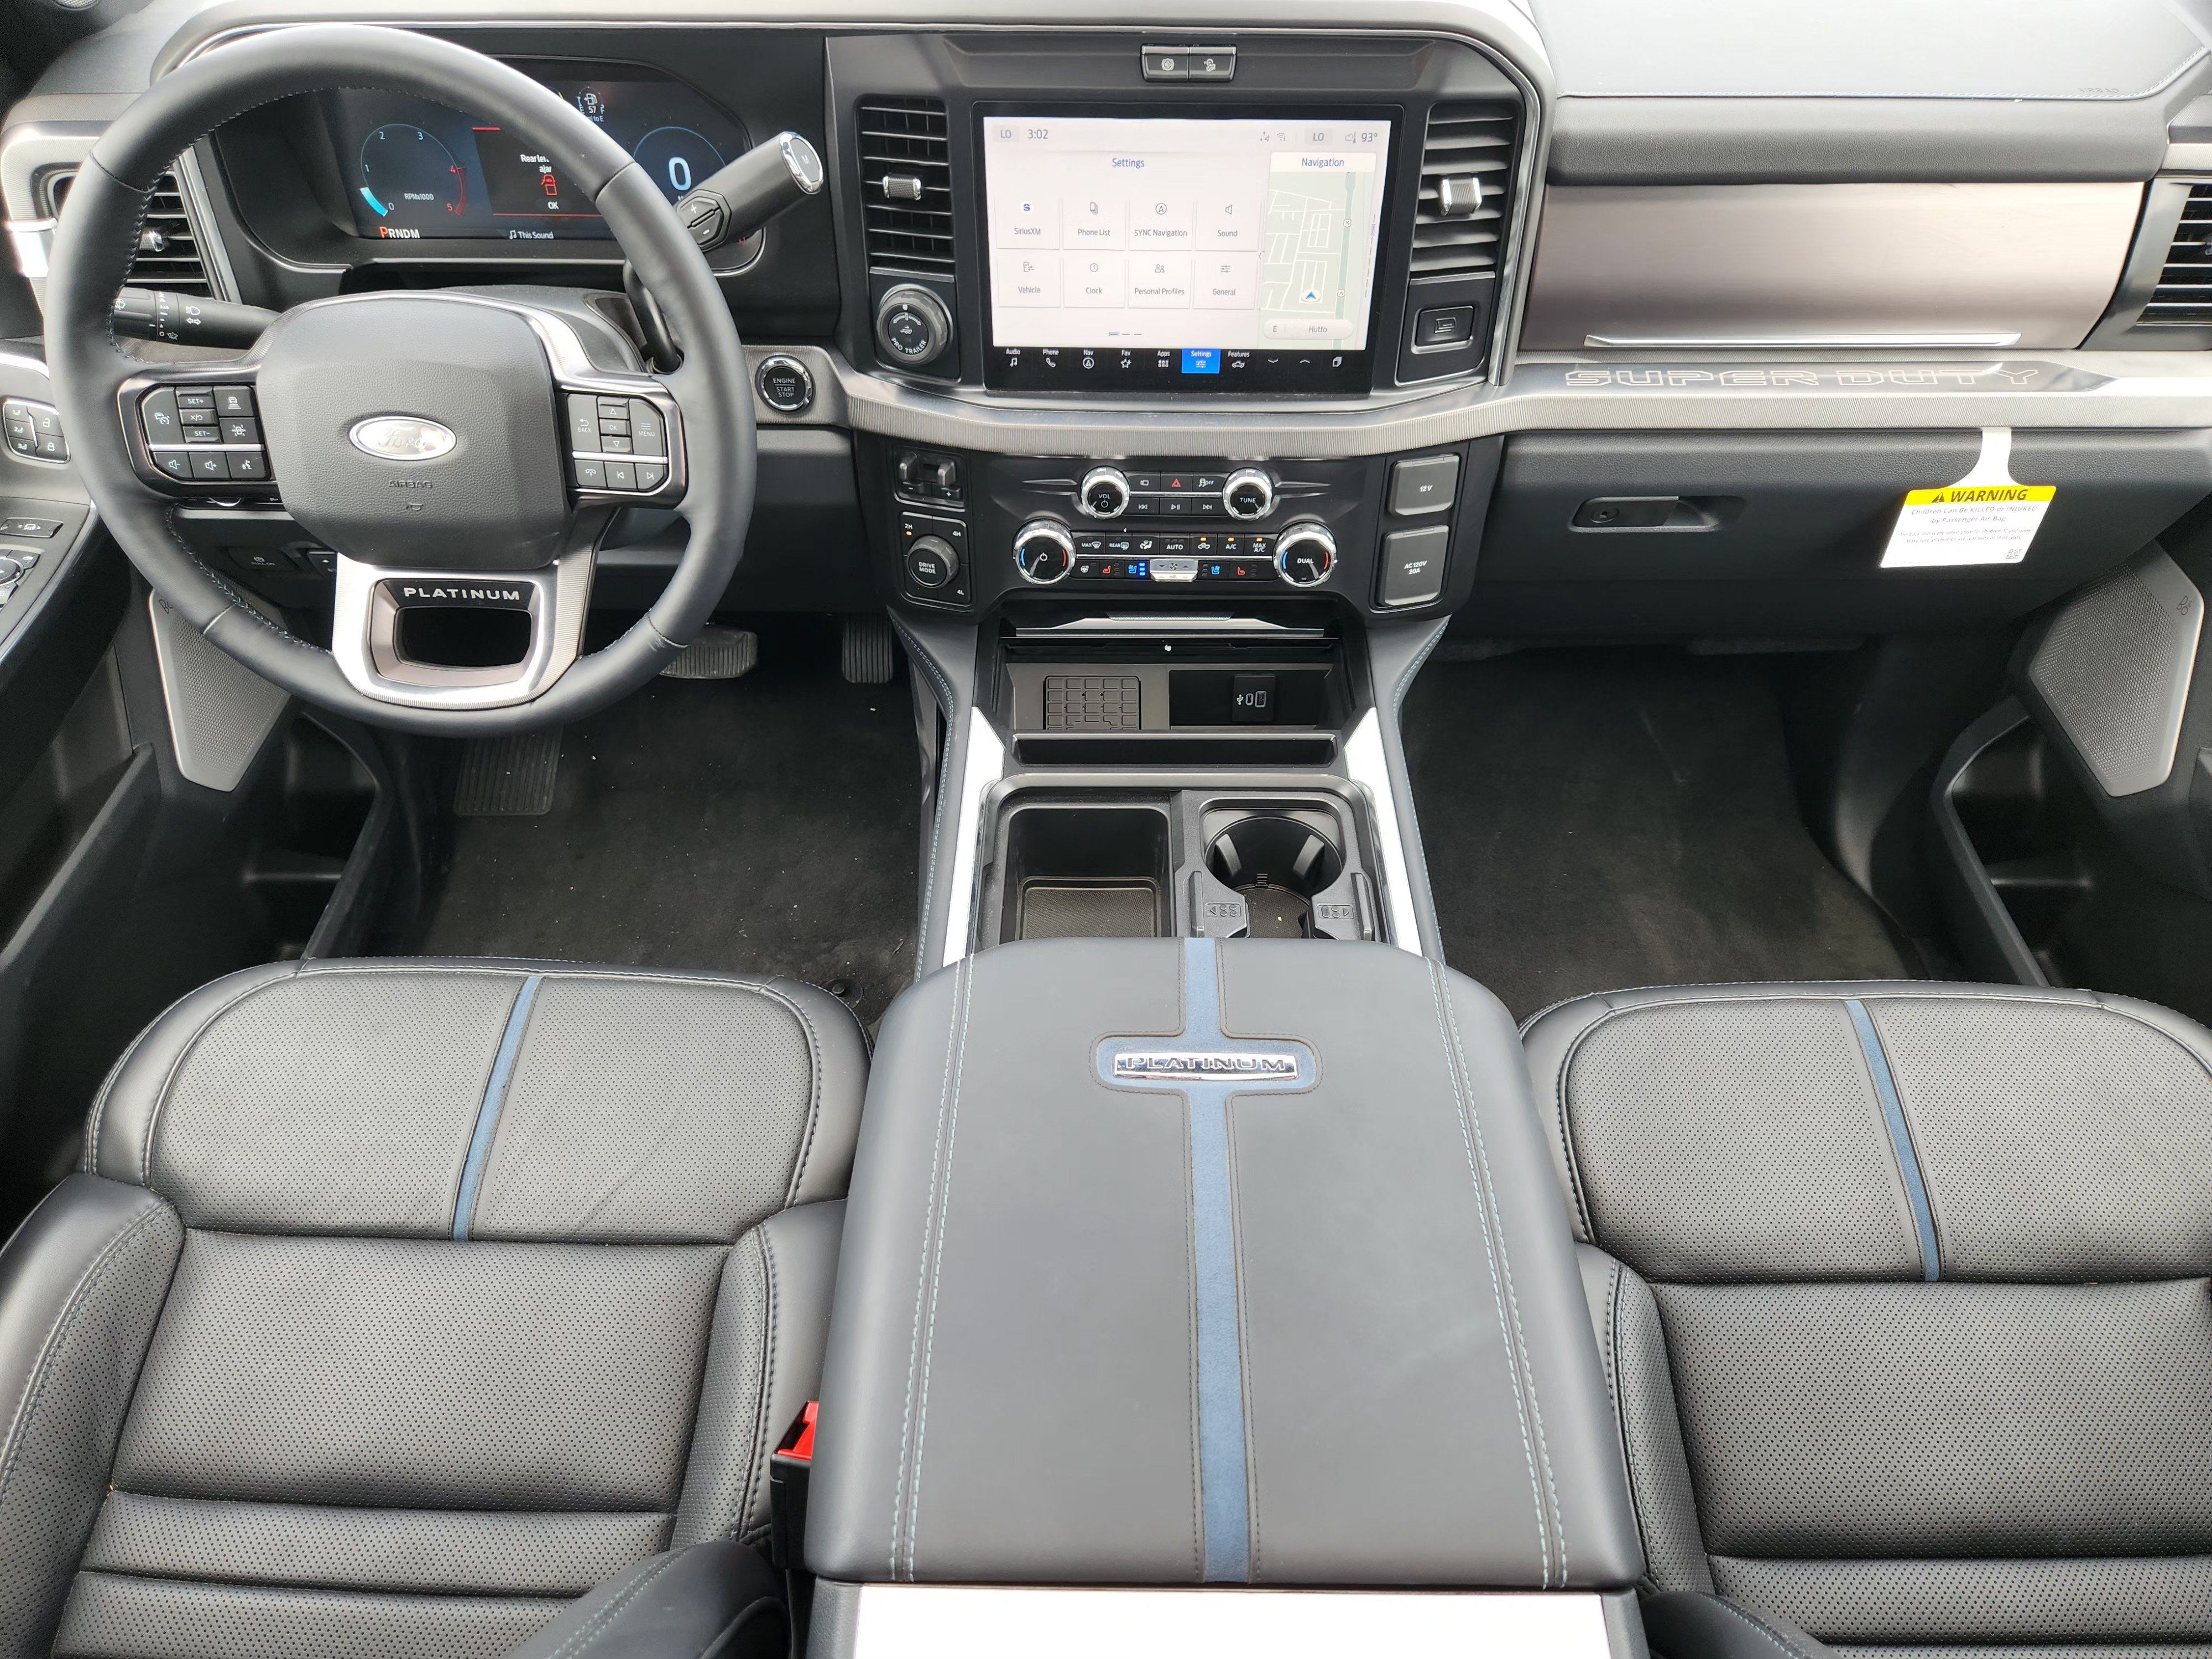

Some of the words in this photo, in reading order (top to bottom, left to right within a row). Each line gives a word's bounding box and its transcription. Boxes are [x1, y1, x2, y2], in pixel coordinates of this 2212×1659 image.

[588, 106, 596, 114] 57
[379, 131, 385, 140] 2
[418, 132, 424, 140] 3
[1000, 129, 1011, 138] LO
[1027, 129, 1048, 139] 3:02
[1313, 133, 1324, 142] LO
[520, 154, 537, 163] Rear
[1301, 158, 1344, 168] Navigation
[1112, 158, 1145, 169] Settings
[365, 164, 369, 173] 1
[539, 165, 552, 174] ajar
[669, 156, 691, 191] 0
[388, 202, 395, 211] 0
[547, 201, 559, 210] OK
[518, 231, 532, 239] This
[533, 231, 554, 239] Sound
[1014, 227, 1041, 236] SiriusXM
[1153, 229, 1187, 238] Navigation
[891, 338, 903, 351] PRO
[905, 340, 927, 354] TRAILER
[1565, 370, 1819, 386] SUPER
[1835, 369, 2039, 385] DUTY
[389, 480, 433, 489] AIRBAG
[1950, 489, 2028, 503] WARNING
[403, 587, 520, 600] PLATINUM
[1126, 1057, 1286, 1071] PLATINUM
